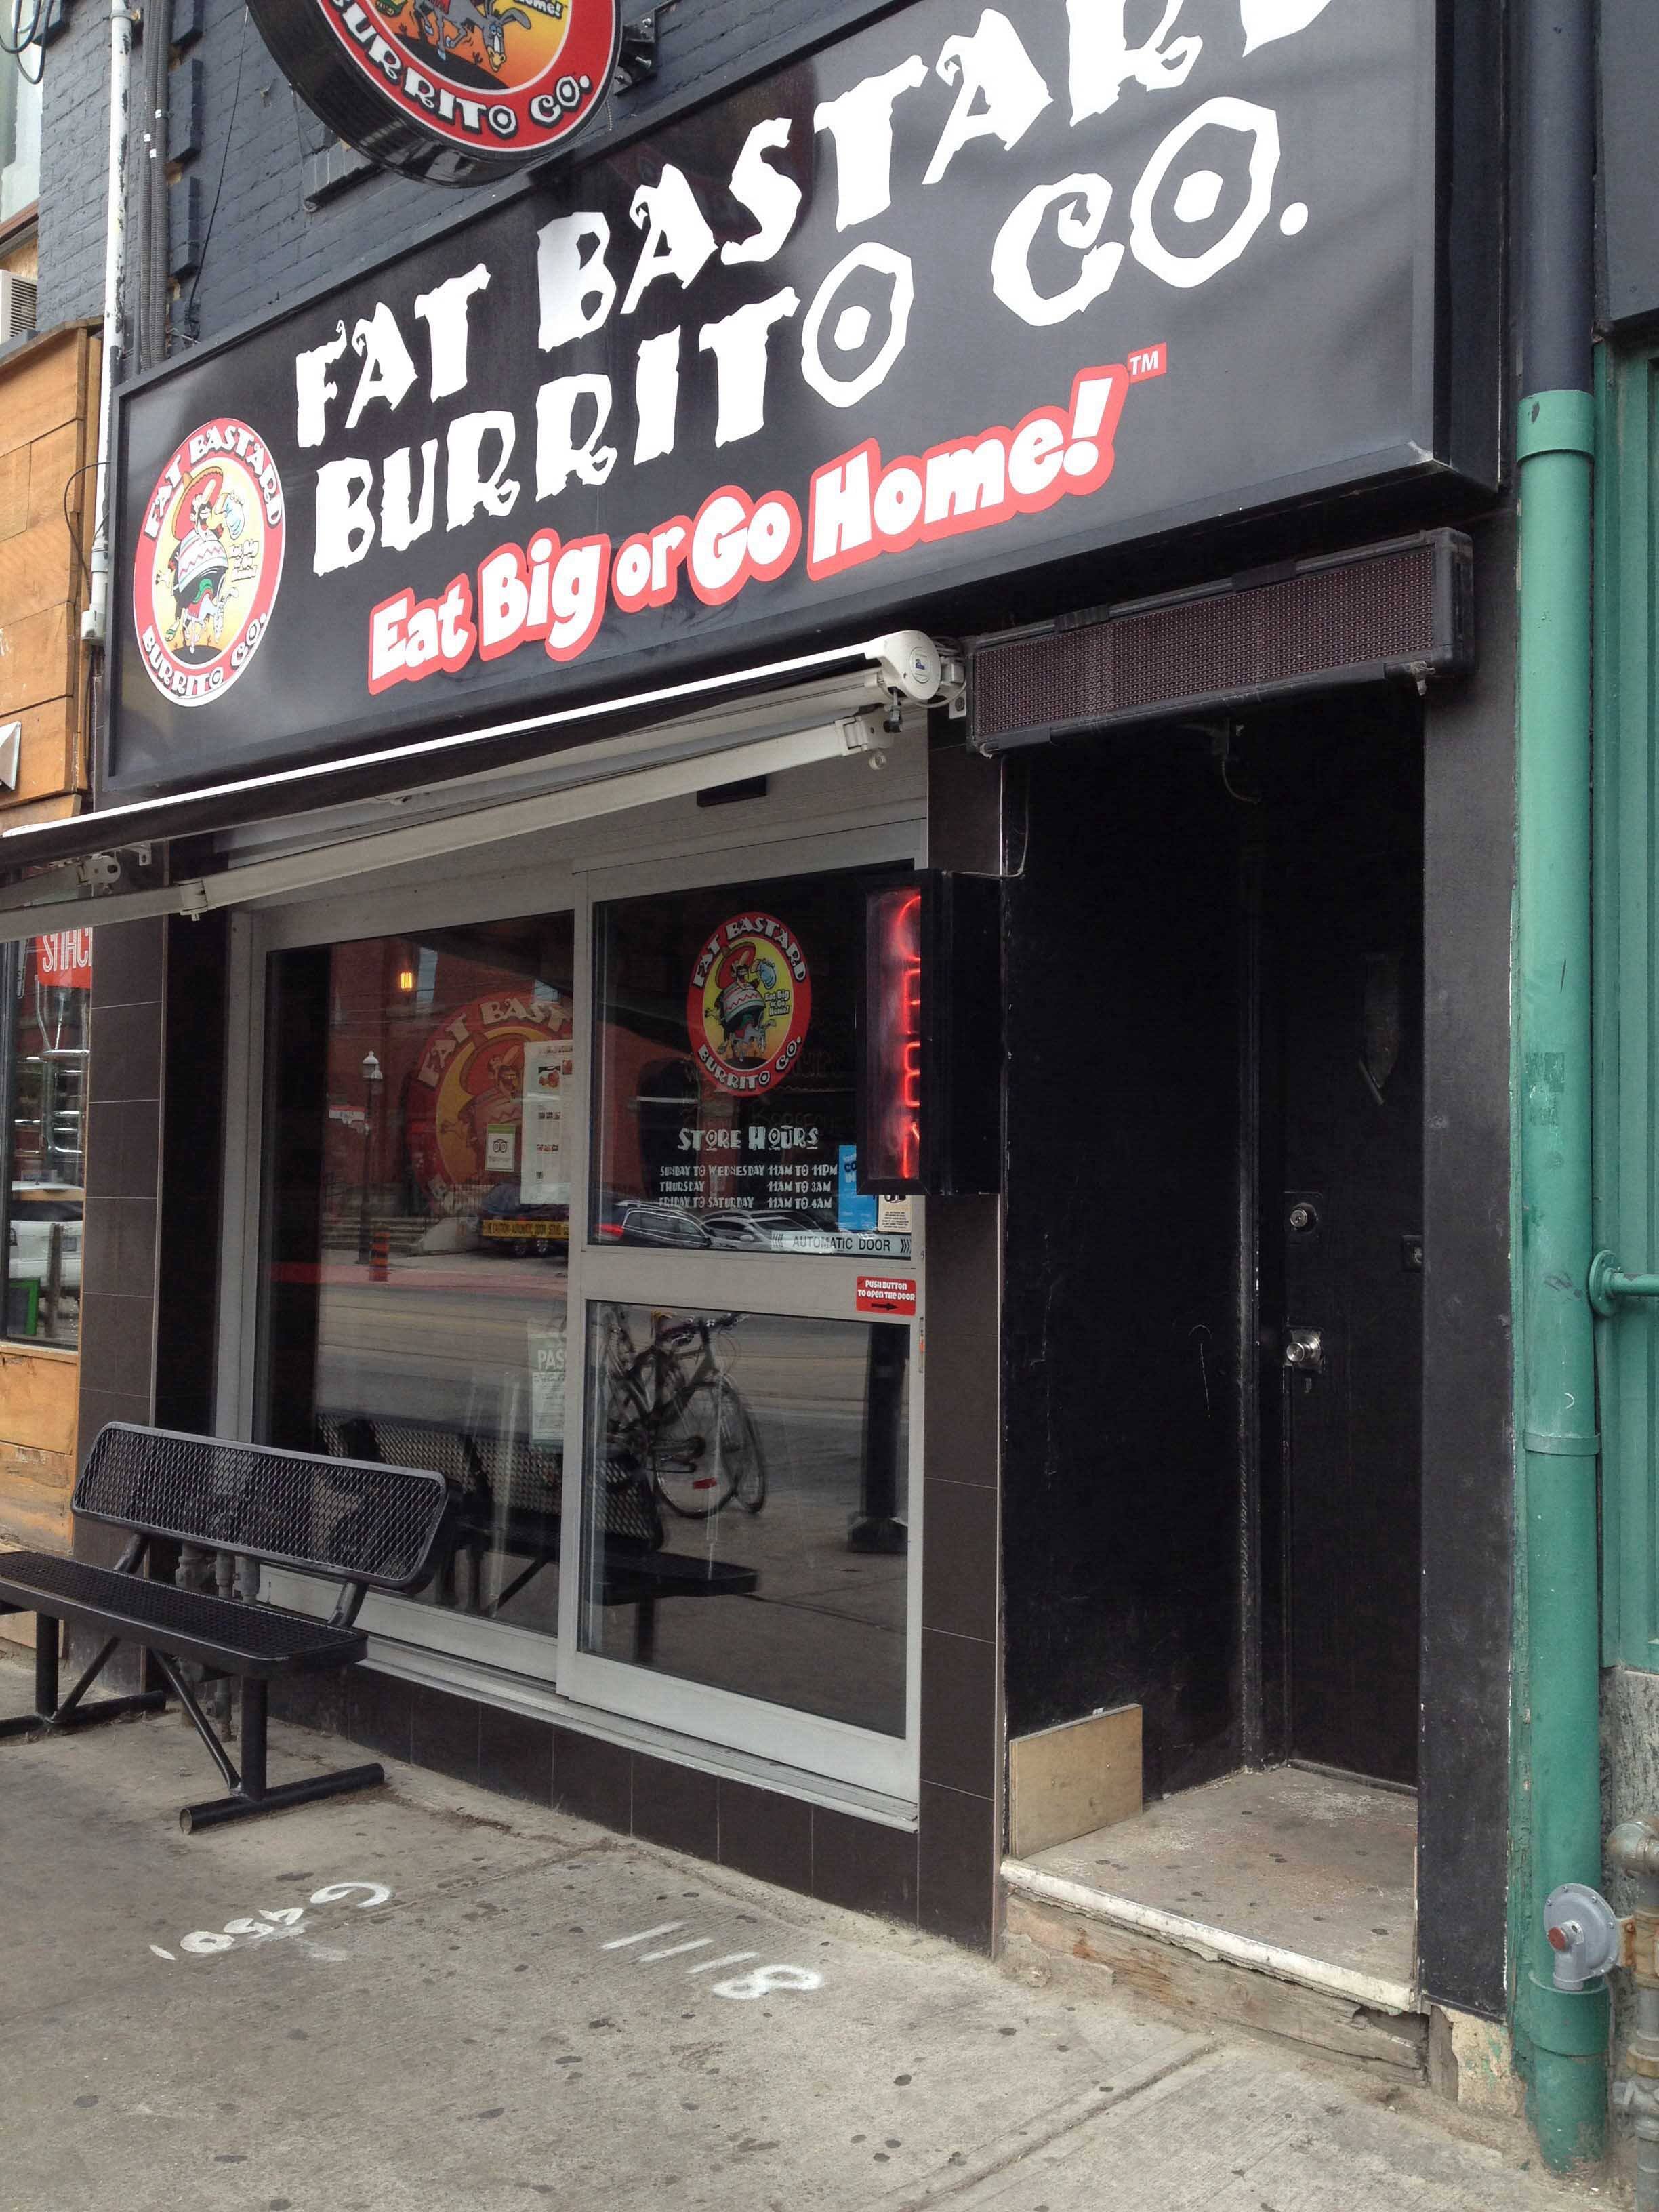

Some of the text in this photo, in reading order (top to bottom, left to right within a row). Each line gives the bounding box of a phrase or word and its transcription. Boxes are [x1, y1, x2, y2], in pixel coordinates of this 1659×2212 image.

[331, 0, 591, 134] URRITO CO.
[296, 0, 1332, 447] FAT BASTAR
[313, 96, 1309, 576] BURRITO CO.
[144, 425, 283, 539] FAT BASTARD
[371, 583, 469, 681] Eat
[480, 537, 601, 649] Big
[615, 527, 686, 599] or
[691, 495, 791, 590] Go
[812, 377, 1113, 564] Home!
[142, 612, 267, 695] BURRITO CO.
[693, 916, 806, 987] FAT BASTARD
[698, 1036, 802, 1090] BURRITO CO.
[660, 1165, 691, 1176] SUNDAY
[693, 1165, 705, 1176] TO
[708, 1164, 766, 1176] WEDNESDAY
[795, 1165, 808, 1176] TO
[678, 1125, 819, 1151] STORE HOURS
[659, 1197, 691, 1209] FRIDAY
[693, 1197, 705, 1209] TO
[708, 1197, 754, 1209] SATURDAY
[795, 1197, 808, 1209] TO
[811, 1197, 832, 1209] 4AM
[660, 1181, 705, 1193] THURSDAY
[795, 1181, 808, 1193] TO
[793, 1235, 891, 1252] AUTOMATIC DOOR
